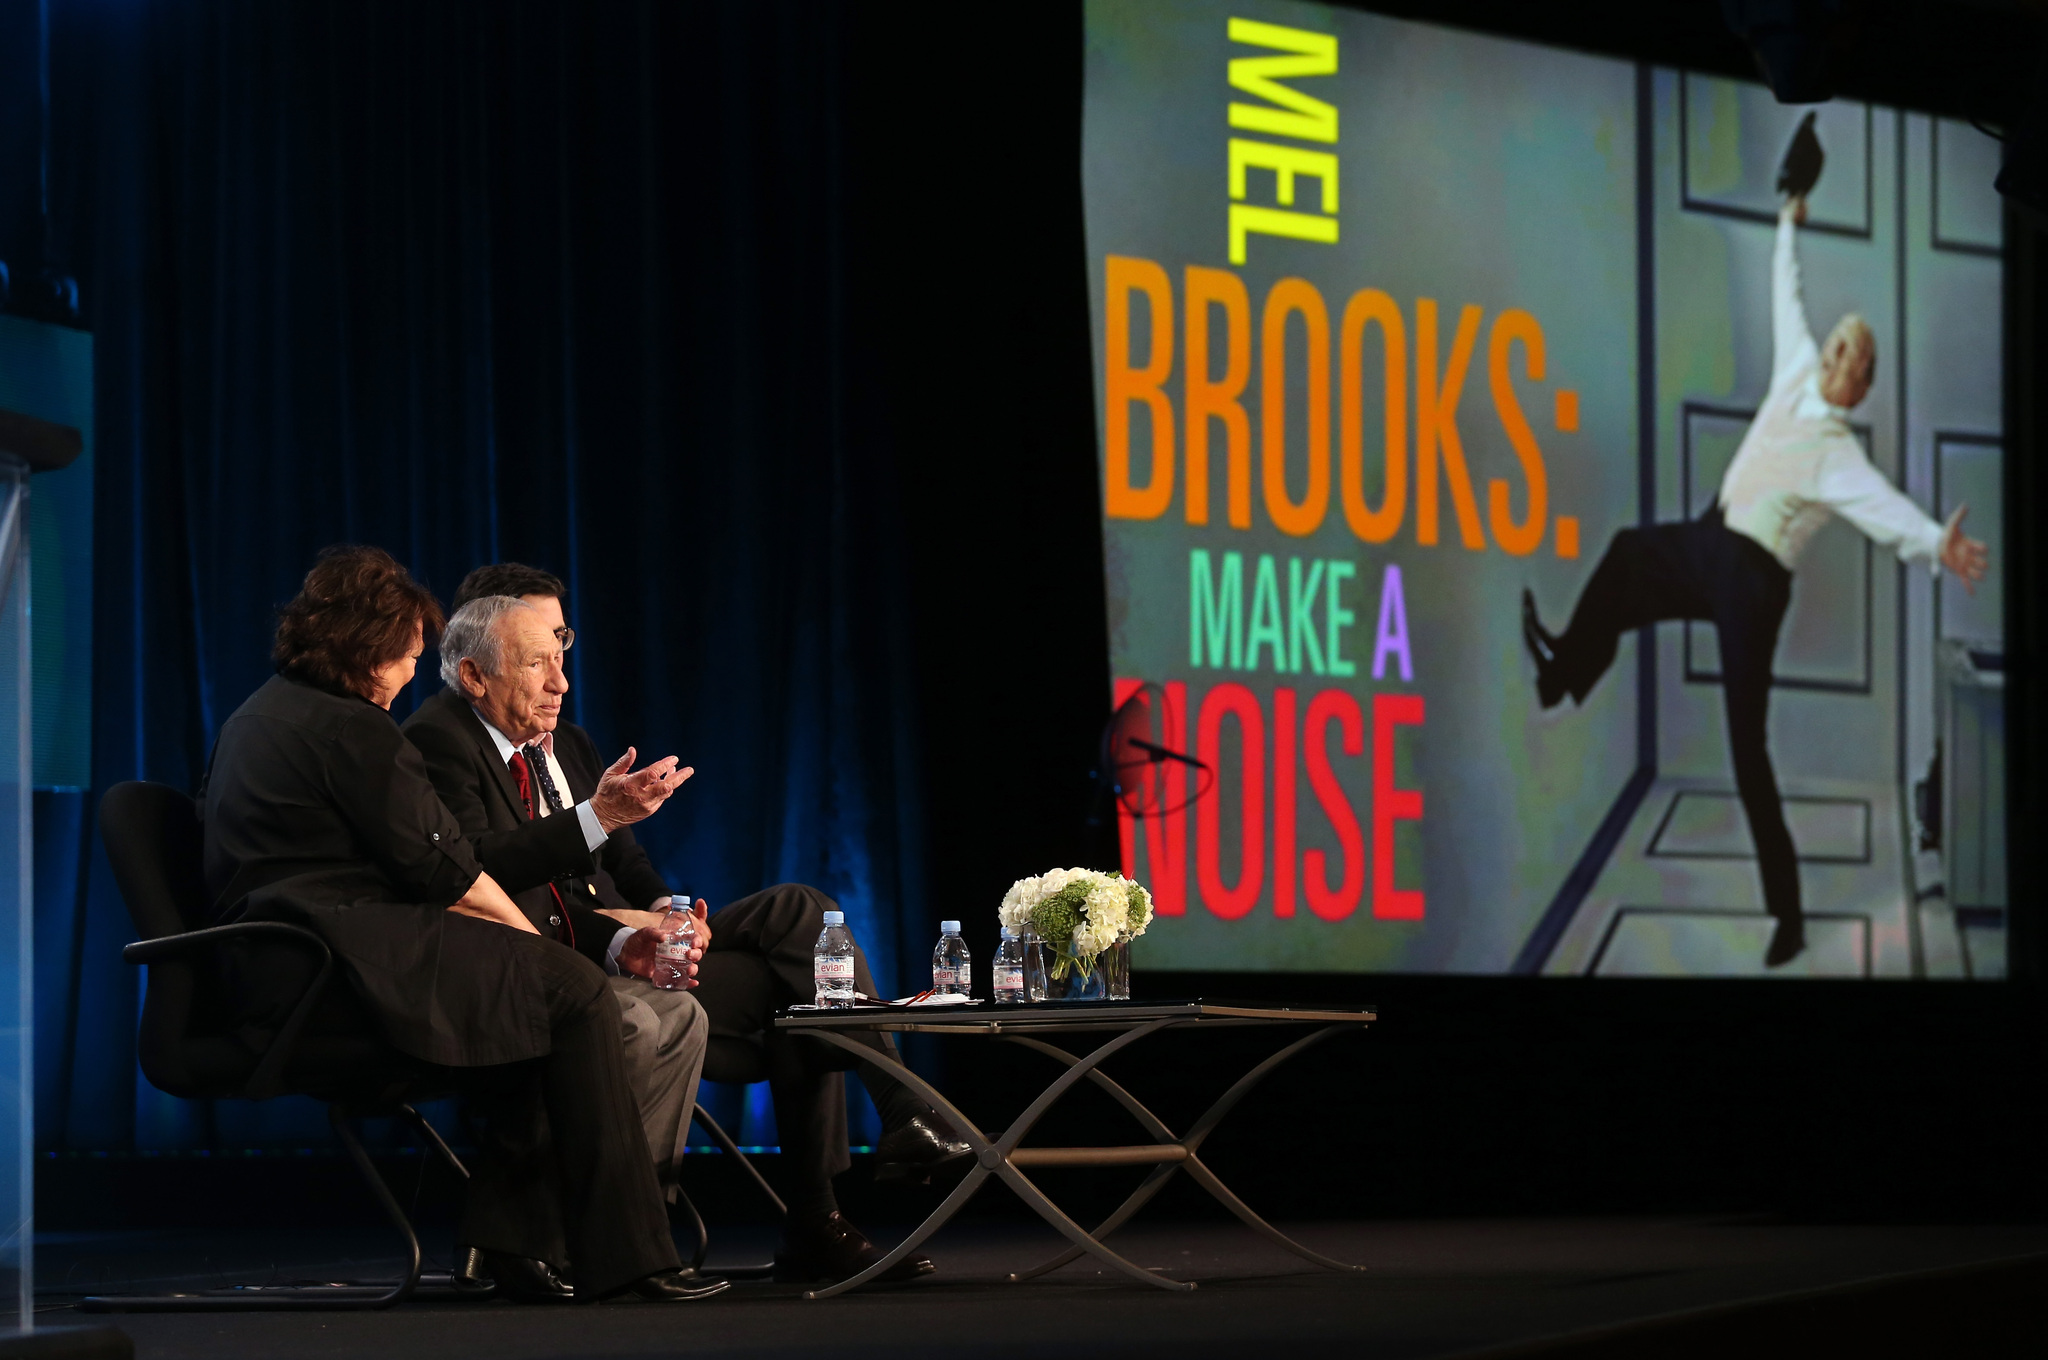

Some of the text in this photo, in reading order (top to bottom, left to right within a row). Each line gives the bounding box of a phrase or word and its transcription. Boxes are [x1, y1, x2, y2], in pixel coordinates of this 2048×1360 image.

[1227, 17, 1338, 265] MEL
[1105, 254, 1579, 559] BROOKS:
[1190, 549, 1414, 681] MAKE A
[1112, 678, 1425, 922] NOISE
[670, 946, 687, 955] evia
[820, 963, 845, 972] evian
[1006, 975, 1023, 984] evia
